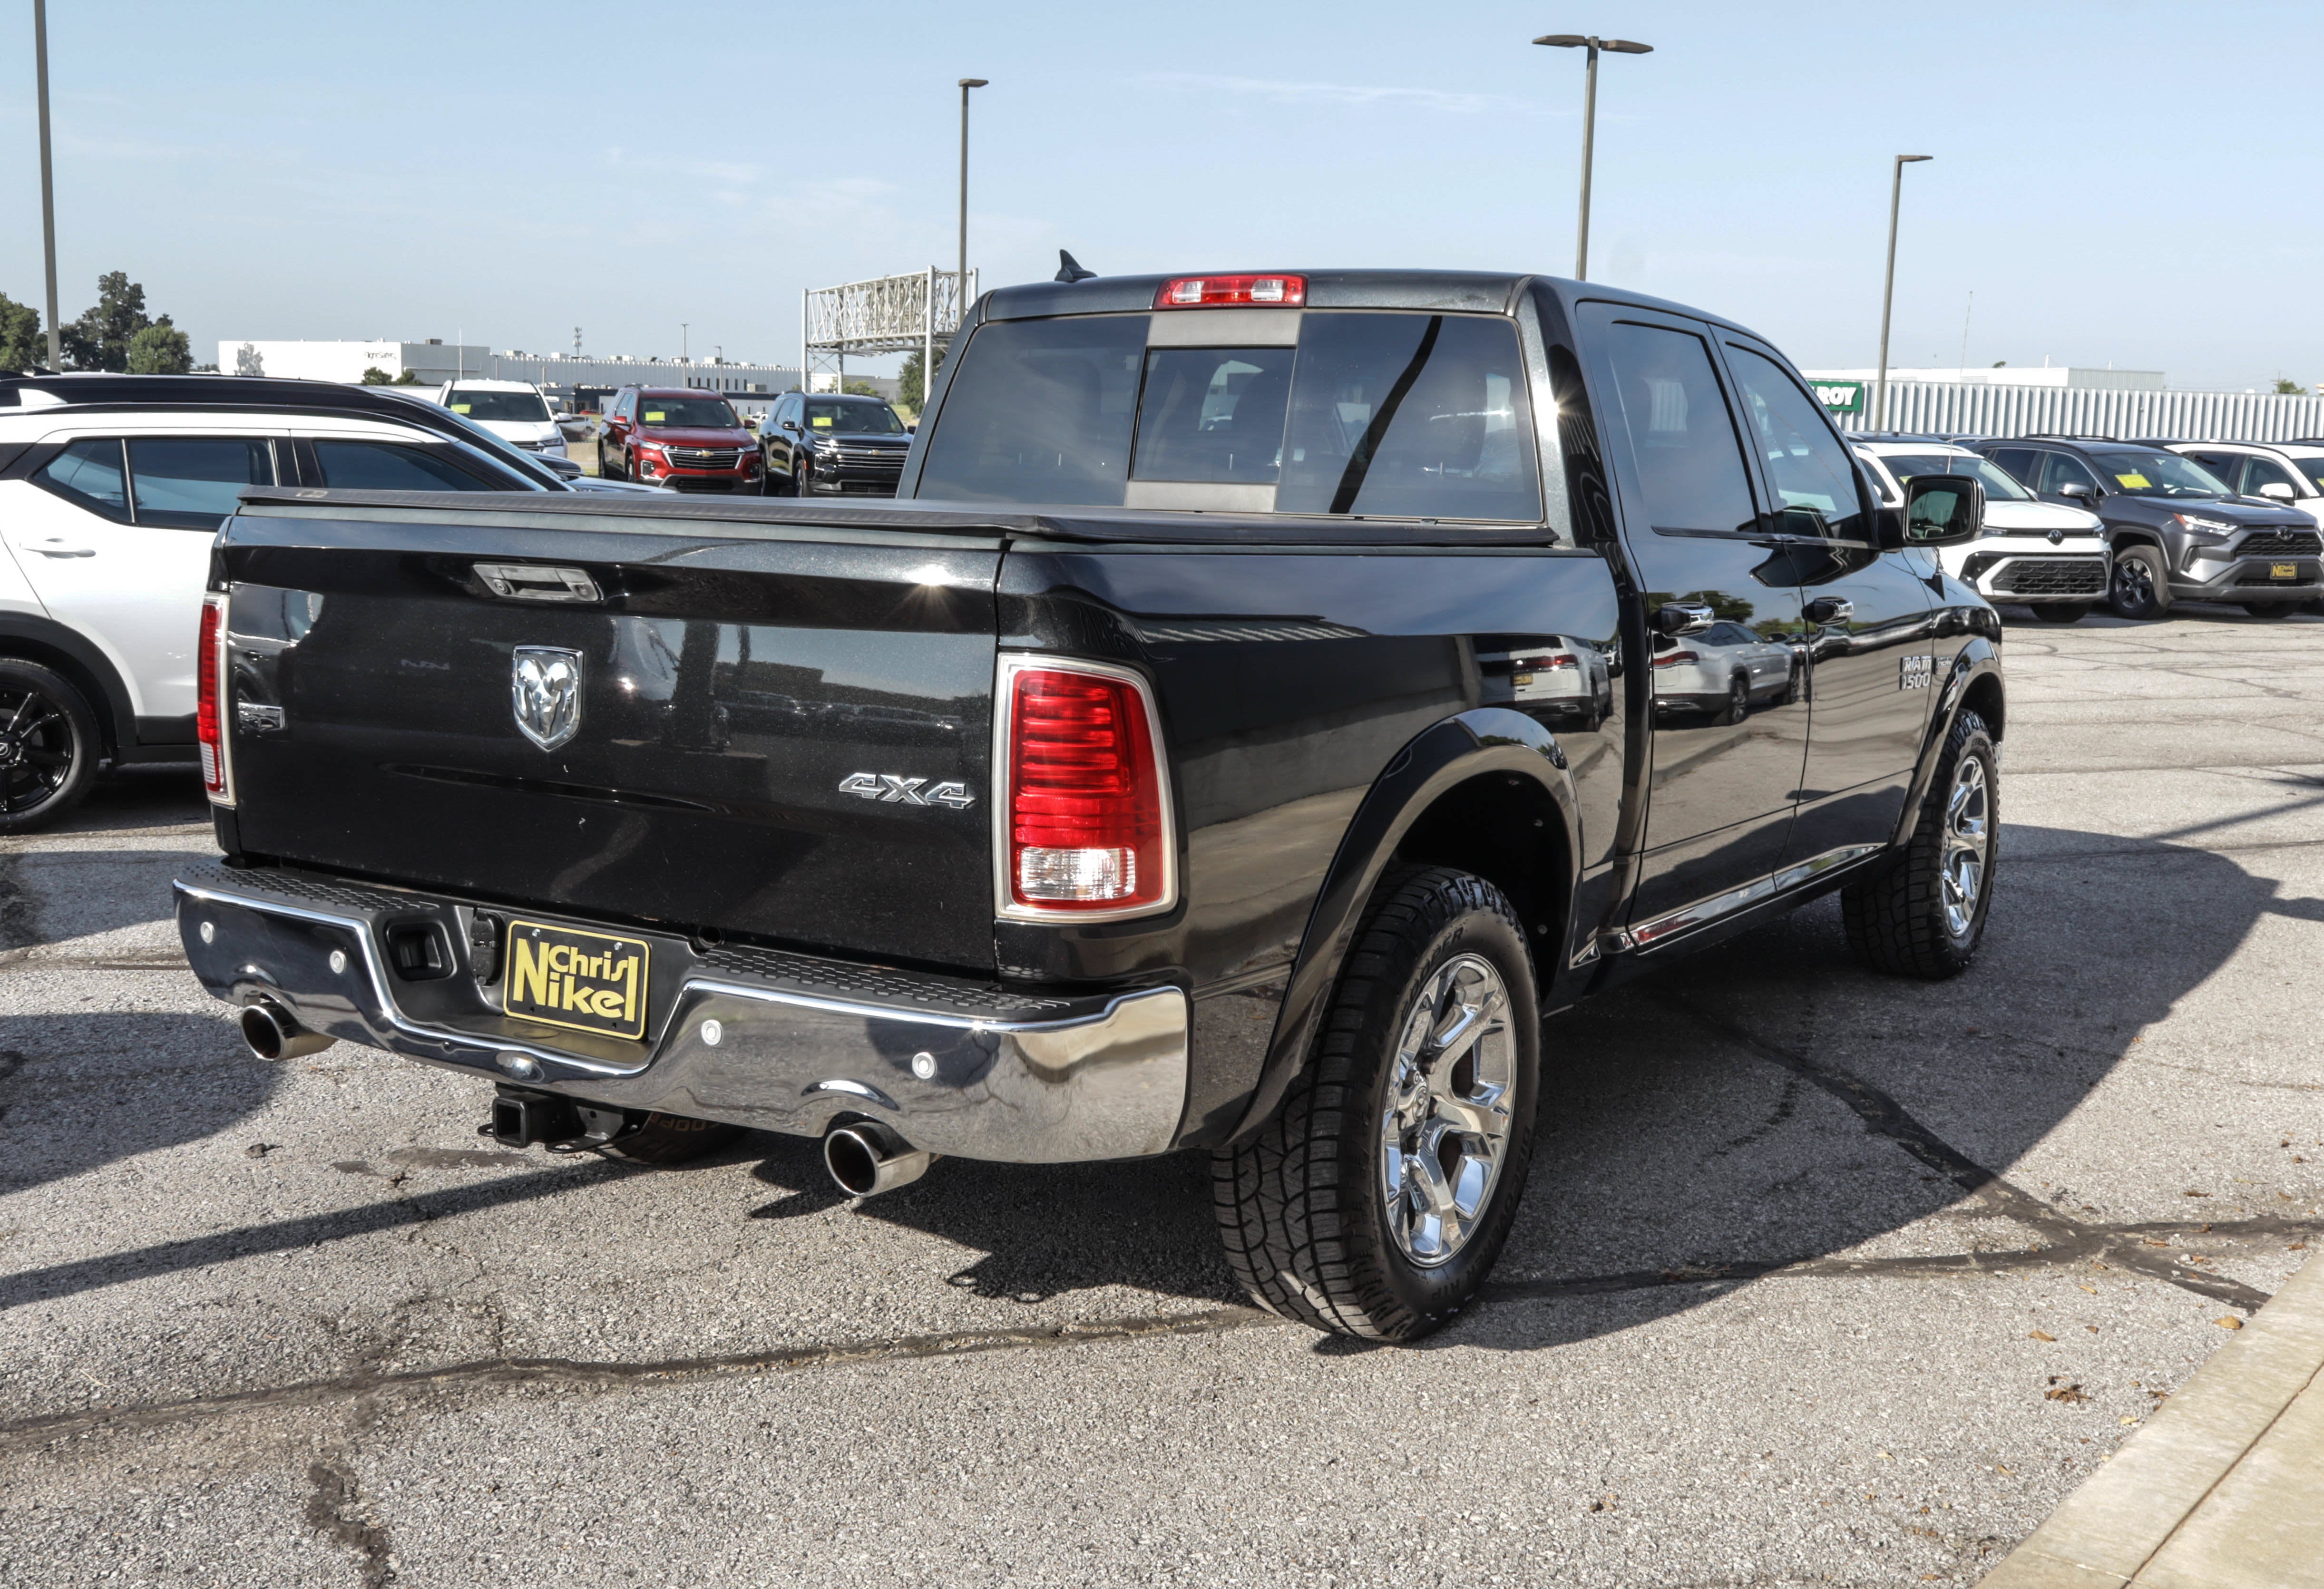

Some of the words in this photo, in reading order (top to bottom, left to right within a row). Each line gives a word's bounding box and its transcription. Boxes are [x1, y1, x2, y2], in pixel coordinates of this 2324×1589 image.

[1811, 386, 1856, 405] ROY
[1902, 655, 1932, 673] RAM
[1900, 672, 1931, 690] 1500
[548, 945, 628, 982] Chris
[513, 937, 639, 1023] Nikel
